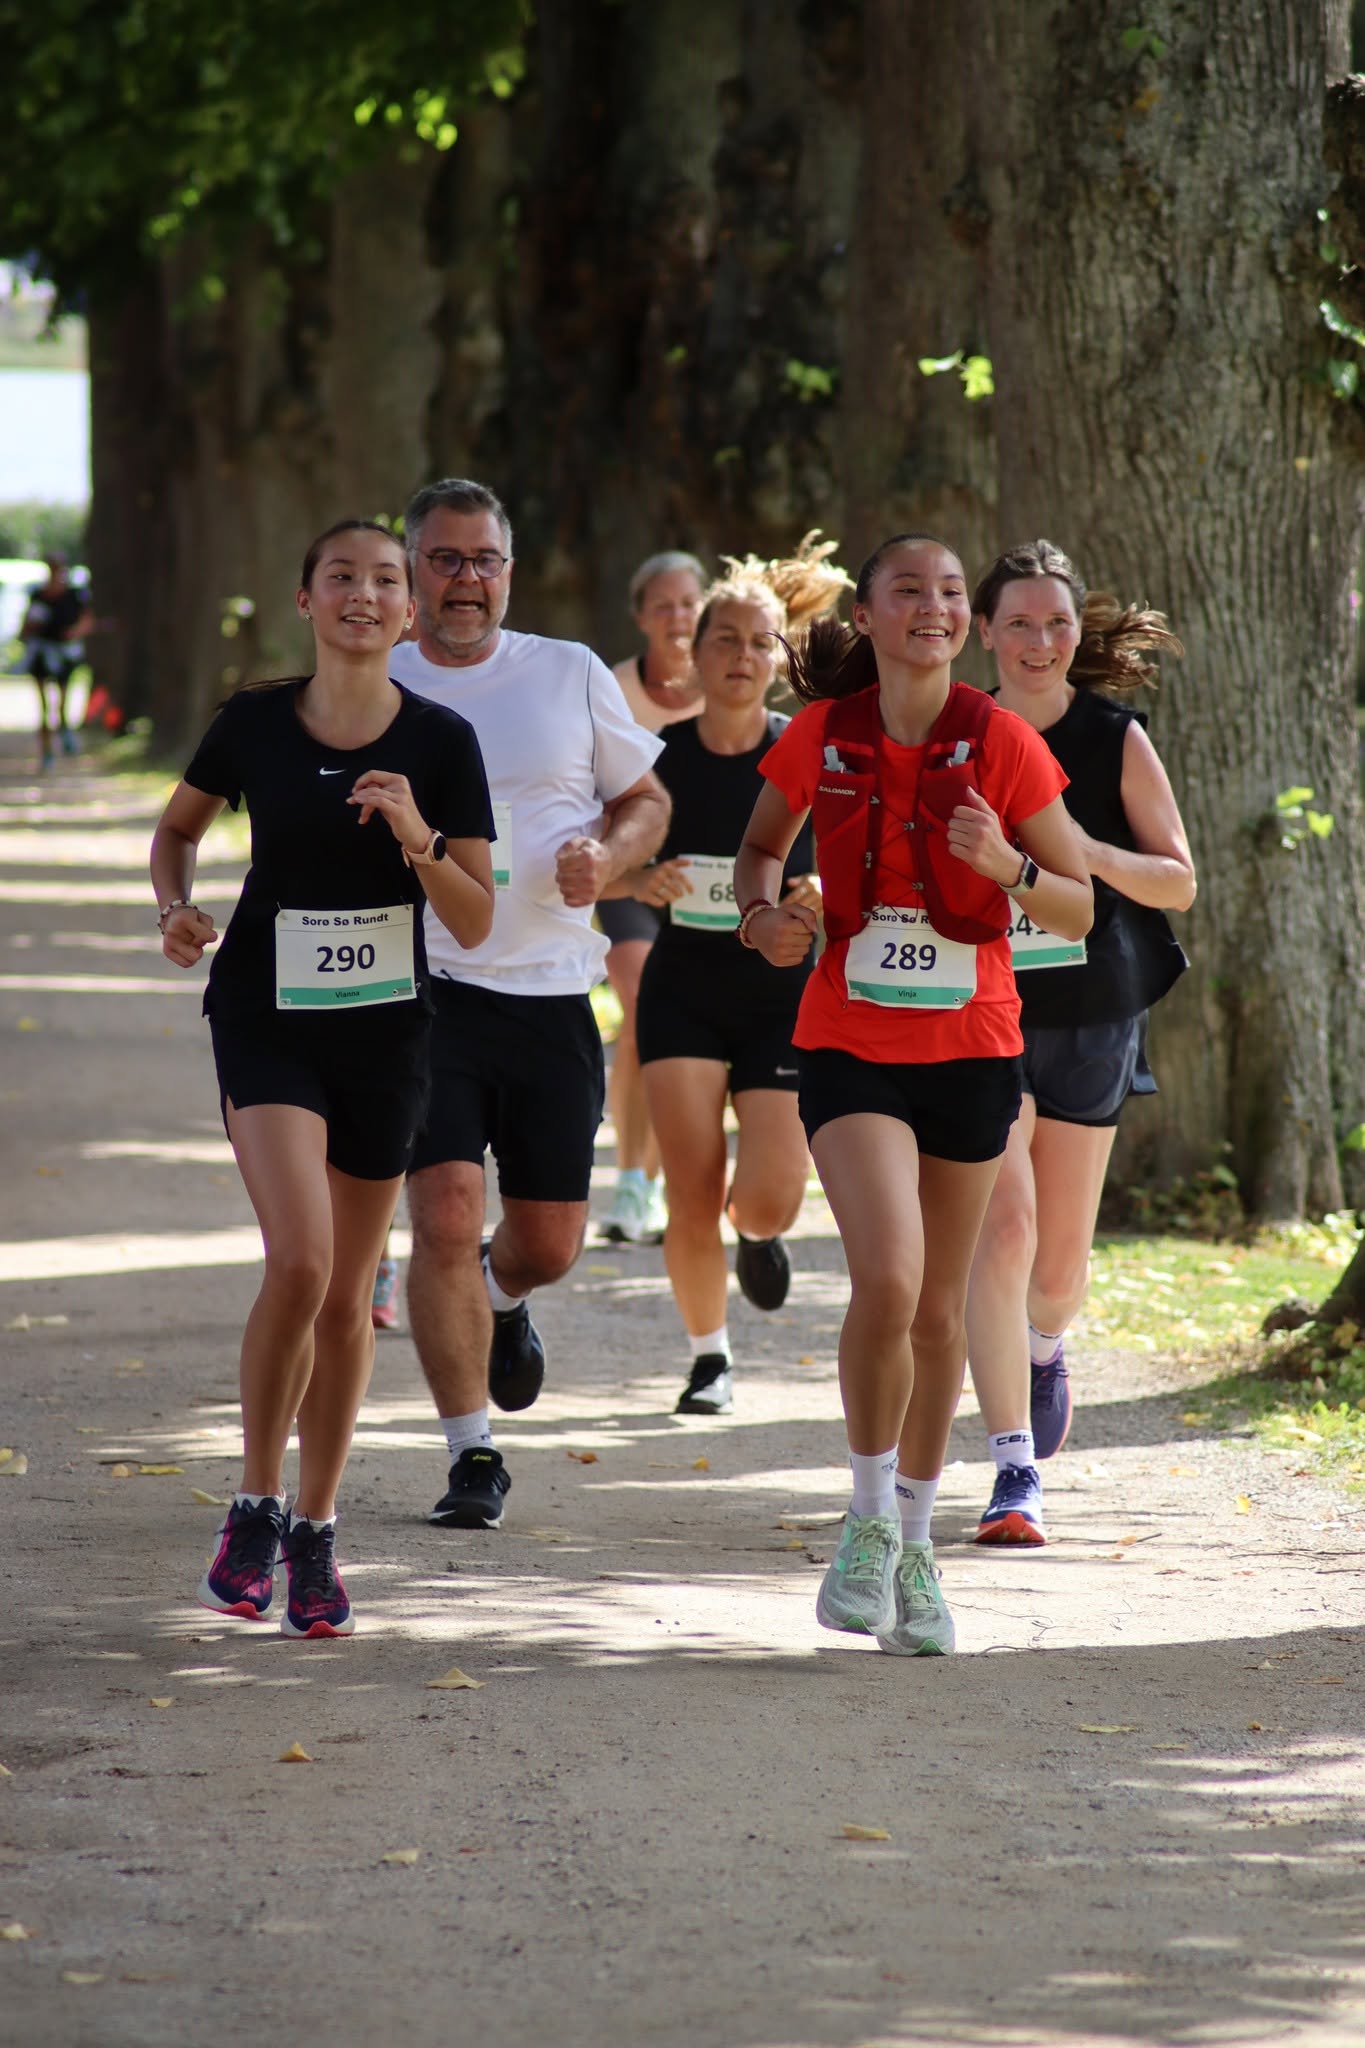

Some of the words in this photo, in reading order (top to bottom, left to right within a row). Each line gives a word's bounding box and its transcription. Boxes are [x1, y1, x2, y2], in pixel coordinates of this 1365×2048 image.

[818, 785, 856, 796] SALOMON
[353, 913, 389, 925] Rundt
[316, 943, 375, 972] 290
[880, 942, 937, 971] 289
[335, 990, 360, 998] Vianna
[898, 990, 917, 998] Vinja
